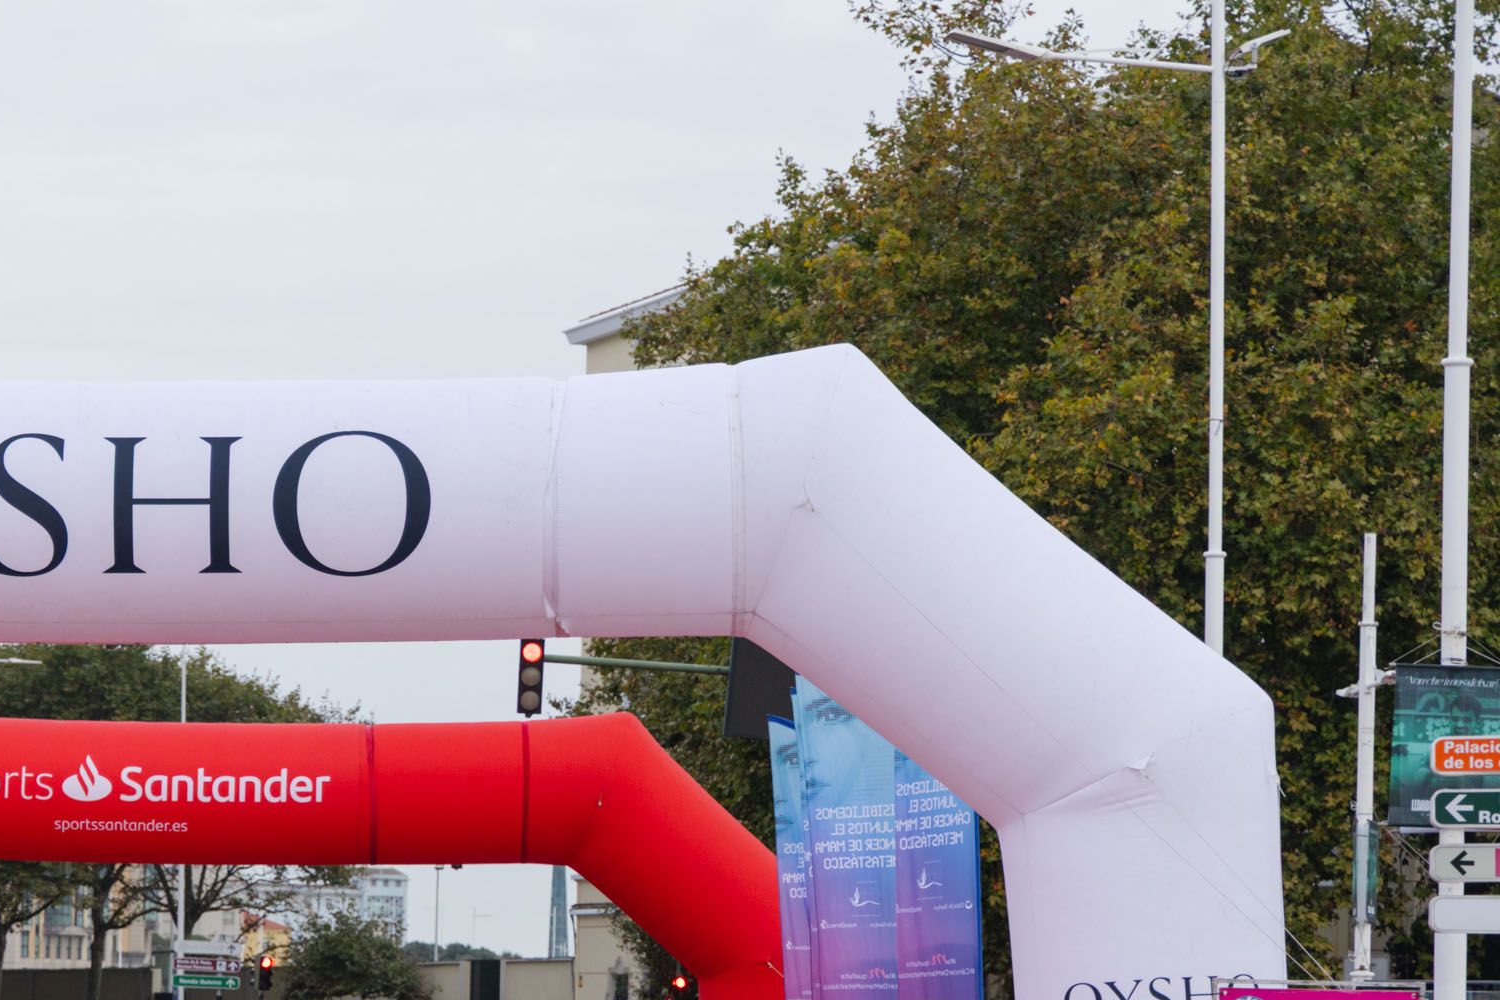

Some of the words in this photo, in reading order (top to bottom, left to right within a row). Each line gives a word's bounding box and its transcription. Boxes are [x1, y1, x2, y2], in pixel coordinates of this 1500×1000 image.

[1443, 757, 1465, 769] de
[1469, 756, 1494, 769] los
[119, 766, 331, 803] Santander
[54, 817, 188, 833] sportssantander.es
